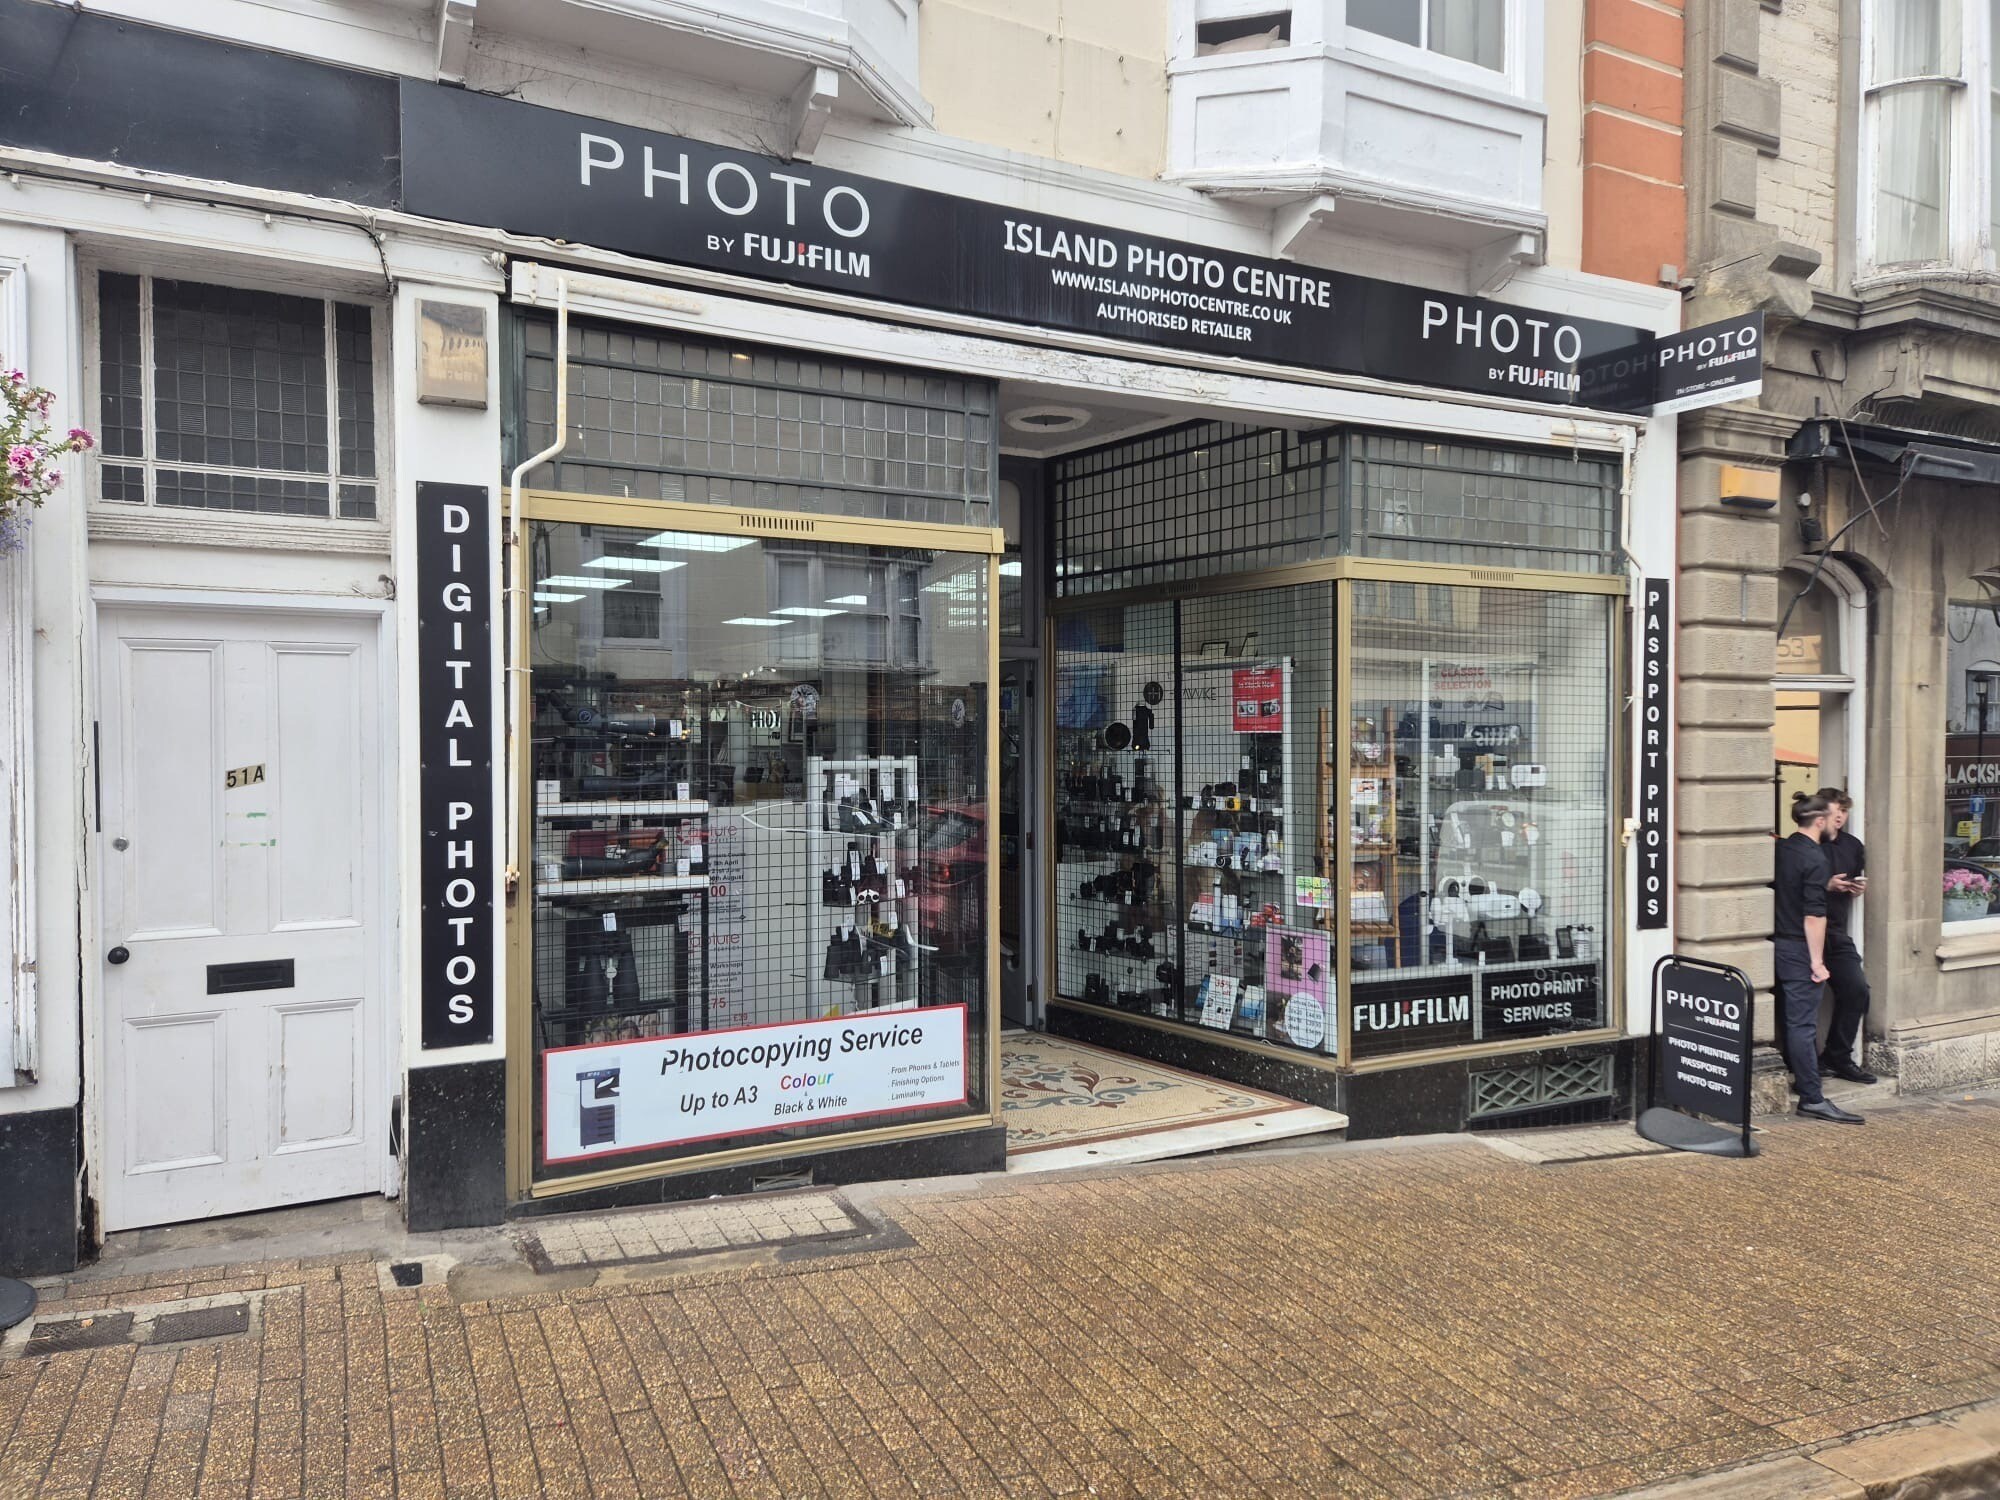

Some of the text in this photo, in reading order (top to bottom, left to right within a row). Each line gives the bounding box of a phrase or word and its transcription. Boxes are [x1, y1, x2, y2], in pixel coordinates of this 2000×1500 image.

[580, 132, 871, 239] PHOTO
[708, 232, 871, 279] BY FUJIFILM
[1003, 219, 1331, 309] ISLAND PHOTO CENTRE
[1096, 302, 1252, 341] AUTHORISED RETAILER
[1421, 300, 1582, 364] PHOTO
[1659, 326, 1757, 368] PHOTO
[1696, 347, 1757, 371] BY FUJIFILM
[1488, 368, 1505, 382] BY
[1508, 364, 1581, 393] FUJIFILM
[442, 503, 474, 768] DIGITAL
[1434, 679, 1492, 690] SELECTION
[1441, 666, 1485, 678] CLASSIC
[1647, 591, 1660, 769] PASSPORT
[226, 765, 264, 788] 51A
[1646, 784, 1660, 916] PHOTOS
[446, 801, 476, 1025] PHOTOS
[1490, 978, 1585, 1001] PHOTO PRINT
[1353, 994, 1470, 1032] FUJIFILM
[1503, 1001, 1572, 1024] SERVICES
[1666, 989, 1740, 1020] PHOTO
[1703, 1015, 1740, 1032] FUJIFILM
[661, 1024, 924, 1076] Photocopying Service
[1668, 1036, 1740, 1064] PHOTO PRINTING
[891, 1059, 960, 1075] From Phones & Tablets
[1680, 1055, 1728, 1077] PASSPORTS
[780, 1072, 834, 1090] Colour
[891, 1074, 945, 1088] Finishing Options
[891, 1089, 926, 1101] Laminating
[1677, 1071, 1733, 1095] PHOTO GIFTS
[679, 1085, 759, 1116] Up to A3
[774, 1095, 848, 1116] Black & White
